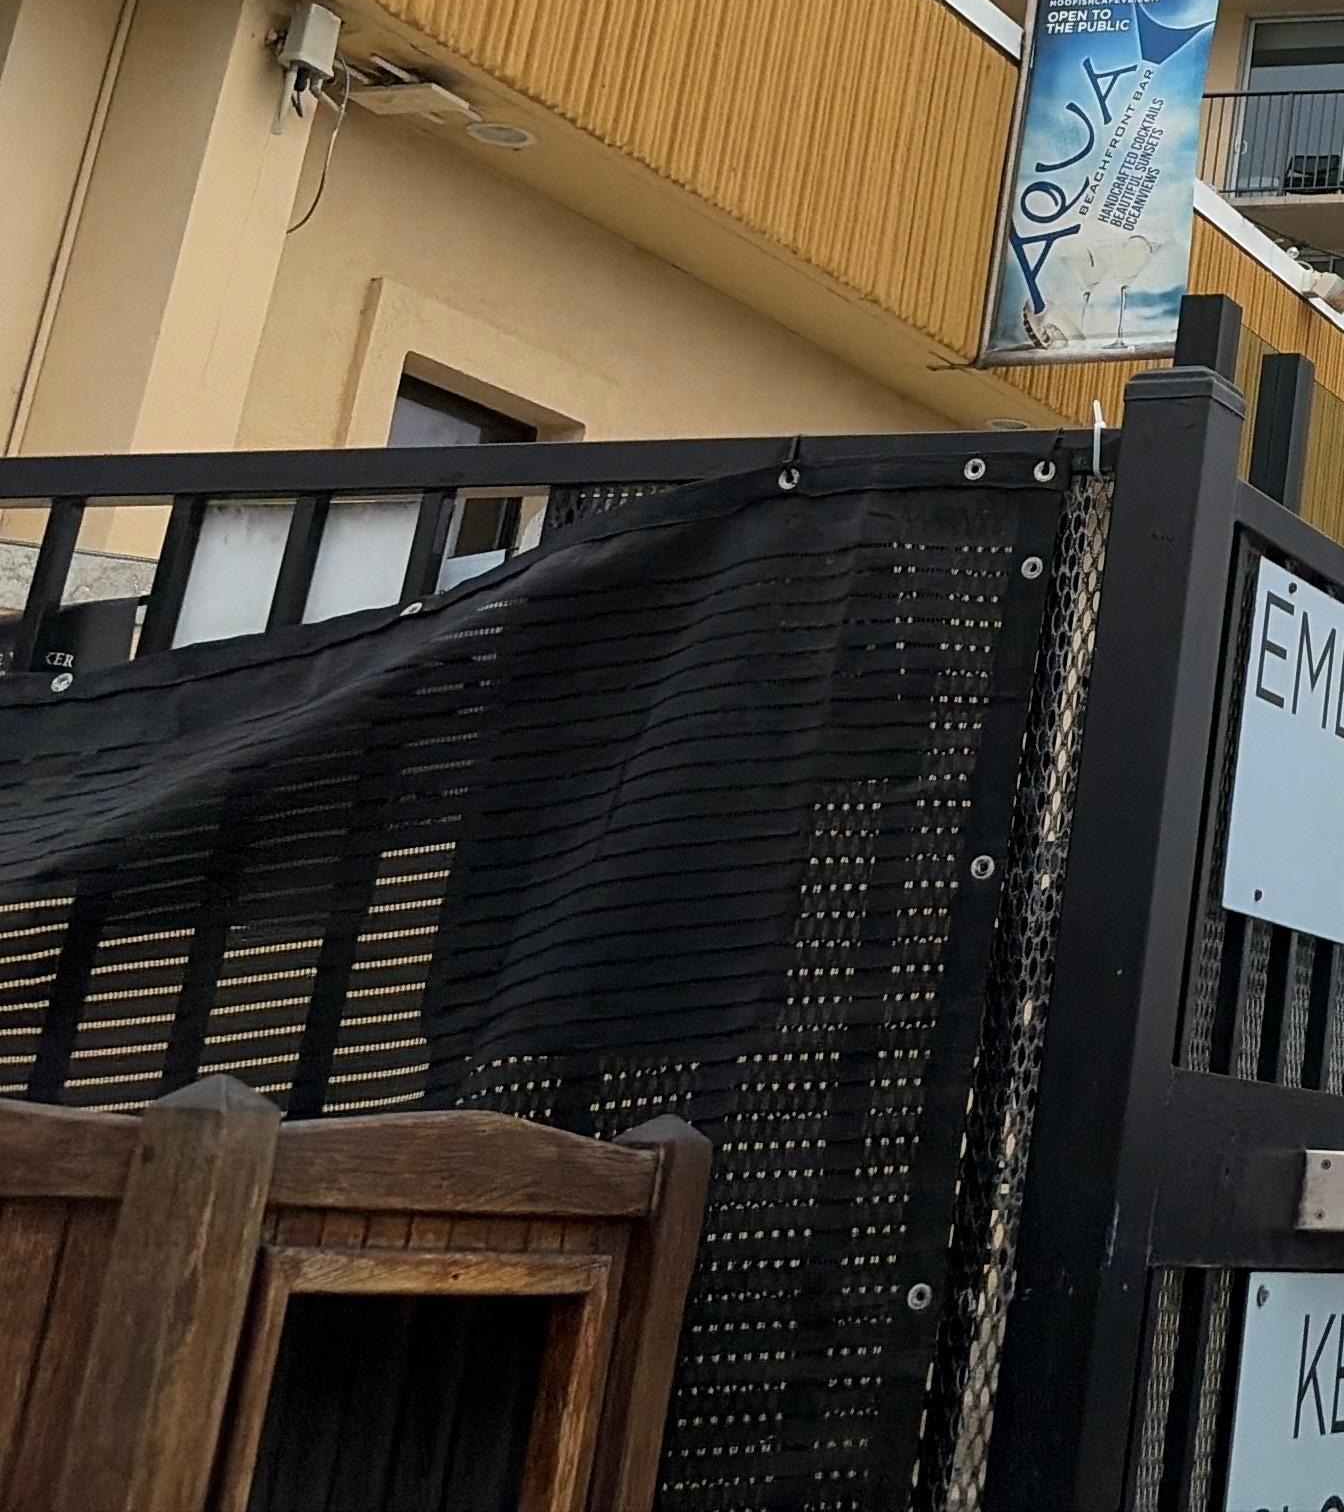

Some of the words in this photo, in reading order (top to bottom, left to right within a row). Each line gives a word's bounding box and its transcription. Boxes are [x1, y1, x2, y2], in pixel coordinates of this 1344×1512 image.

[1046, 22, 1075, 34] THE
[1078, 20, 1130, 33] PUBLIC
[1047, 9, 1088, 23] OPEN
[1092, 8, 1112, 20] TO
[1010, 57, 1138, 315] AQUA
[1079, 103, 1136, 216] BEACHFRONT
[1132, 69, 1155, 101] BAR
[1097, 151, 1139, 224] HANDCRAFTED
[1131, 97, 1164, 151] COCKTAILS
[1110, 175, 1144, 228] BEAUTIFUL
[1135, 127, 1164, 173] SUNSETS
[1122, 166, 1161, 231] OCEANVIEWS
